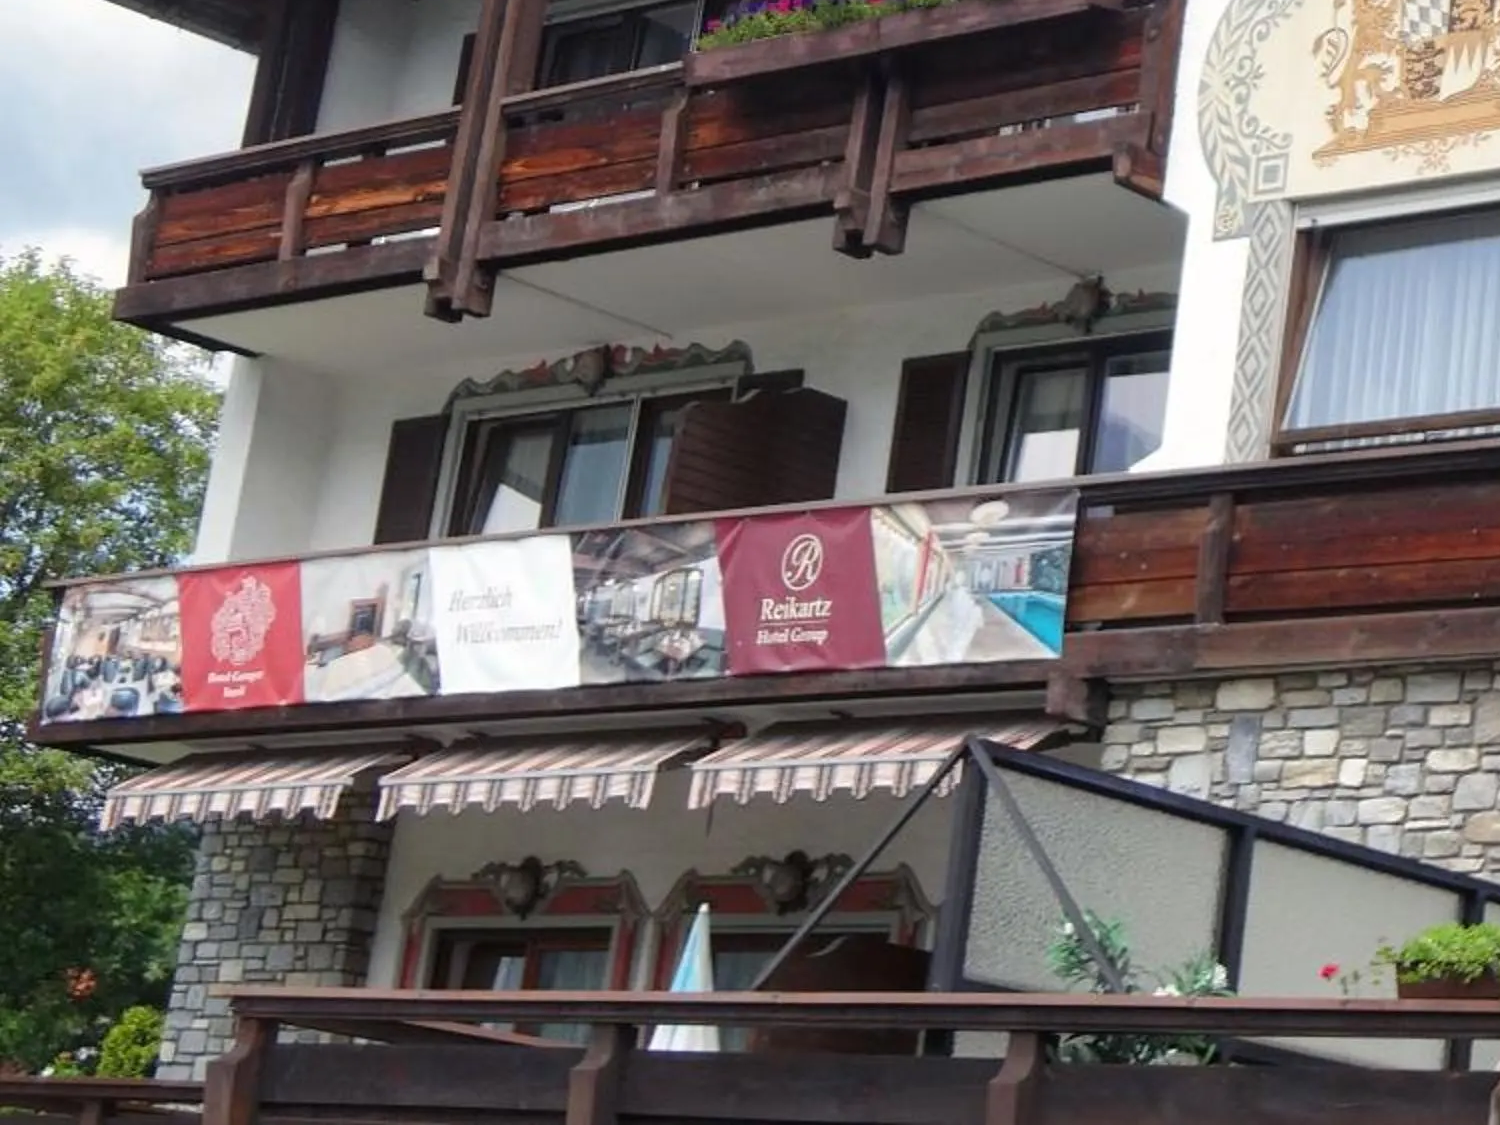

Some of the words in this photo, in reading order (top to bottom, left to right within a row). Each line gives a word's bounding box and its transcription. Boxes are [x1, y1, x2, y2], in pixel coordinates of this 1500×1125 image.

[448, 585, 513, 611] Herzlich
[760, 596, 832, 621] Reikartz
[456, 615, 564, 645] Willkommen!
[756, 628, 789, 645] Hotel
[790, 627, 828, 645] Group
